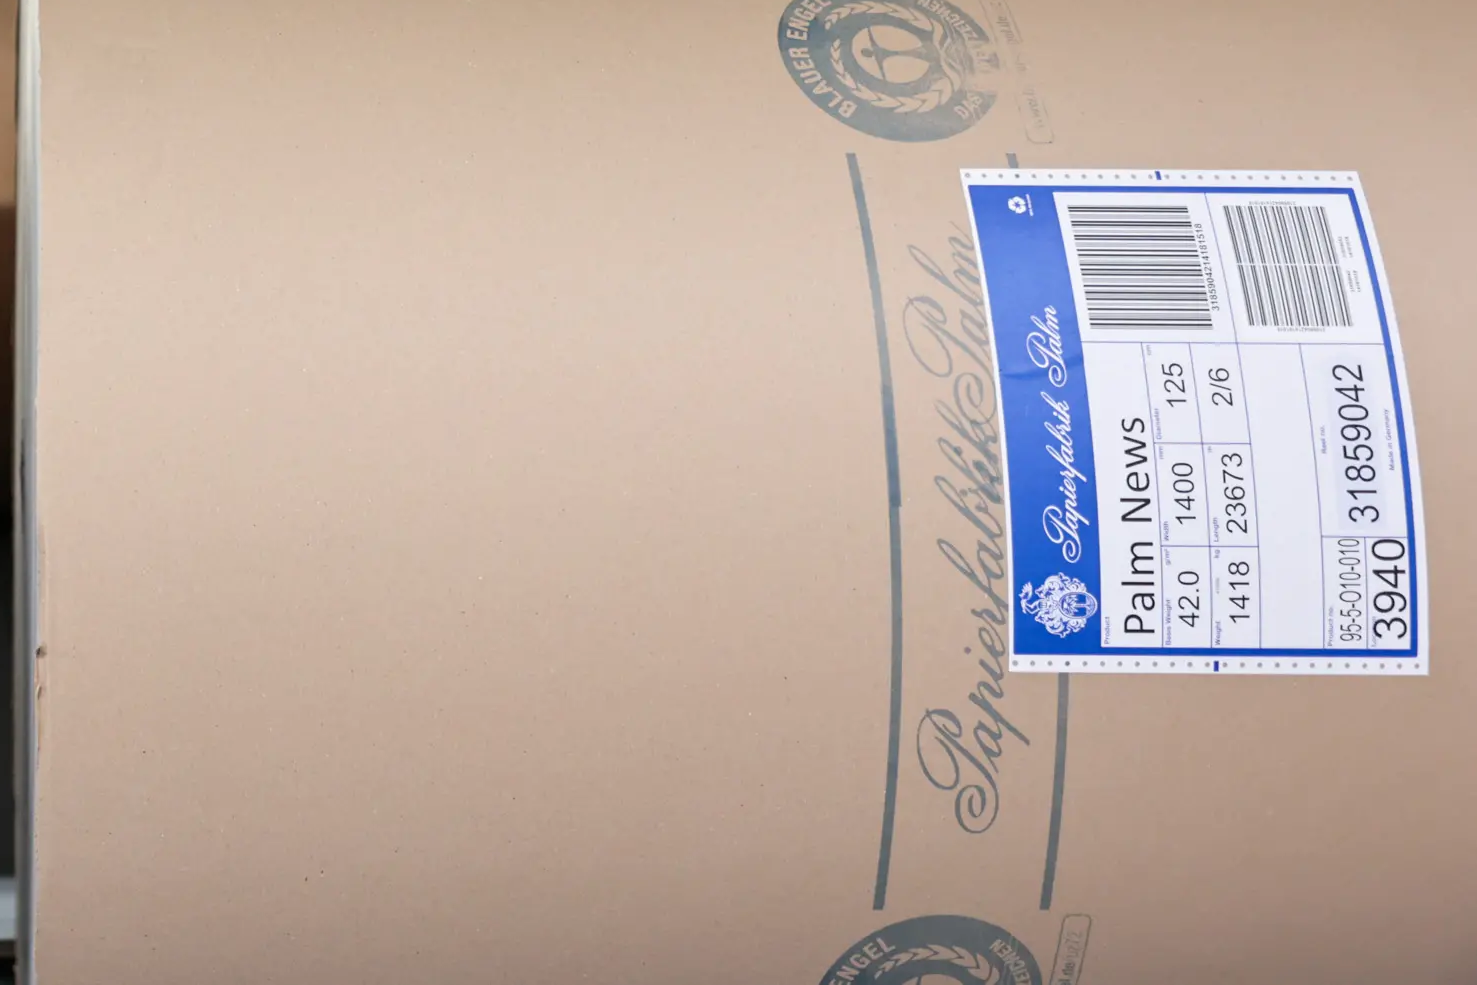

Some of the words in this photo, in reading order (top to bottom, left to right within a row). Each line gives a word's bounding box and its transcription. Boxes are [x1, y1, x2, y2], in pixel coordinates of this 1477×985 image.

[788, 47, 857, 118] BLAUER
[1194, 223, 1219, 311] 3185904214181518
[903, 221, 998, 426] Palm
[1026, 305, 1067, 387] Palm
[1162, 363, 1187, 407] 125
[1208, 368, 1233, 406] 2/6
[1383, 409, 1392, 440] Germany
[1043, 392, 1090, 563] Papierfabrik
[1120, 418, 1152, 522] News
[1332, 364, 1379, 523] 31859042
[1172, 463, 1196, 525] 1400
[1221, 453, 1247, 534] 23673
[1121, 542, 1155, 633] Palm
[1178, 571, 1199, 627] 42.0
[1228, 562, 1250, 623] 1418
[1371, 539, 1407, 639] 3940
